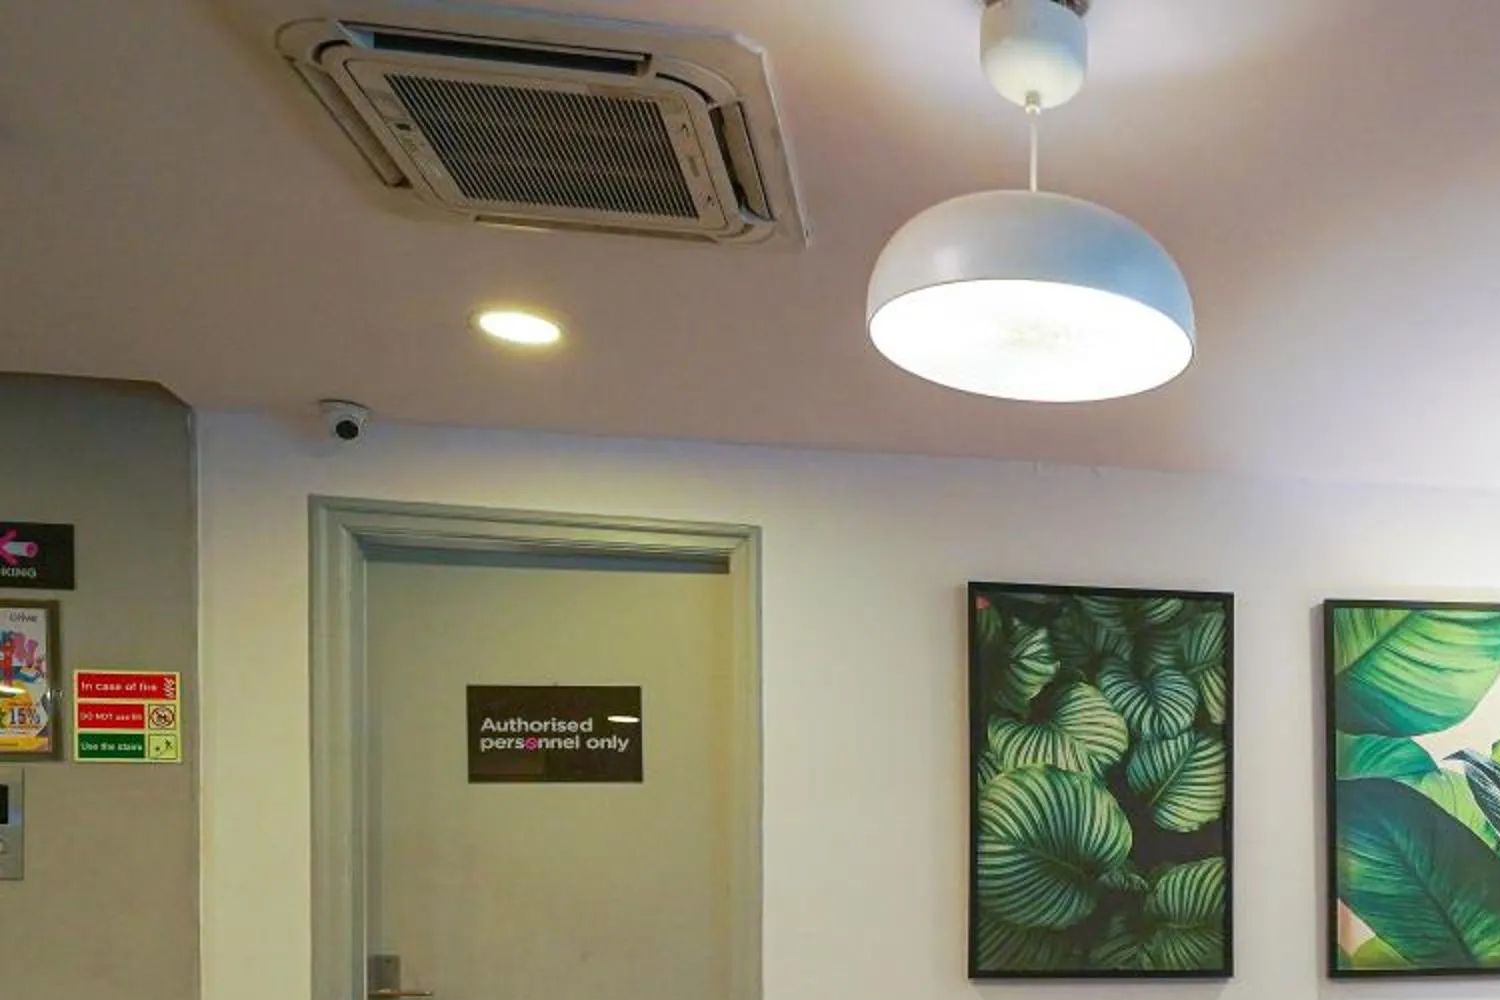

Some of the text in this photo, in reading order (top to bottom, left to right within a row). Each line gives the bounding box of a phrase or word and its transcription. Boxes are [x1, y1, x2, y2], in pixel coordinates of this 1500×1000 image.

[95, 683, 121, 691] case
[480, 717, 593, 733] Authorised
[480, 735, 629, 752] personnel only
